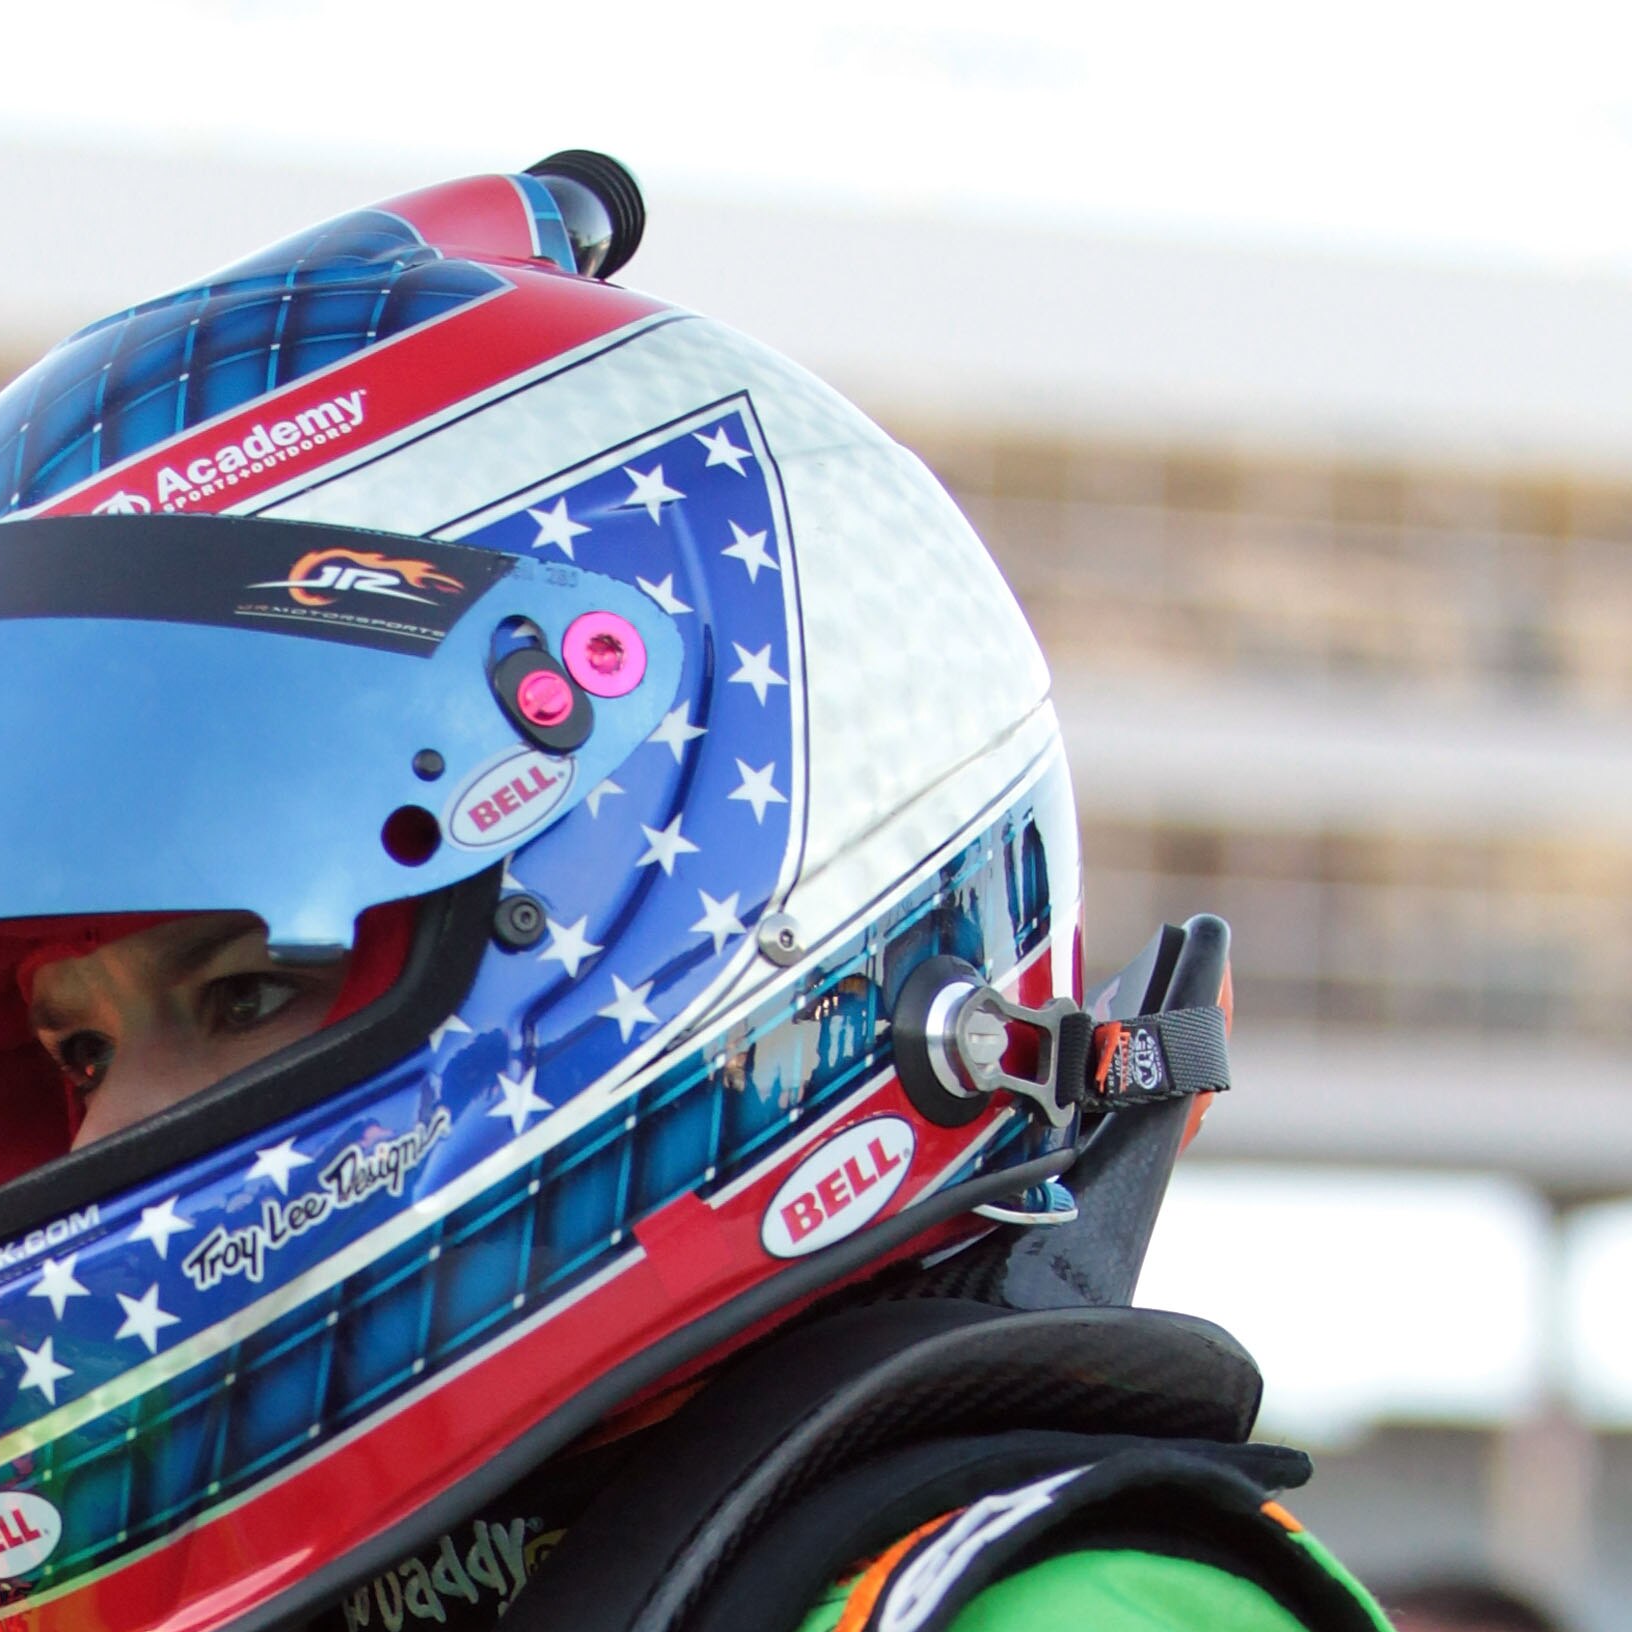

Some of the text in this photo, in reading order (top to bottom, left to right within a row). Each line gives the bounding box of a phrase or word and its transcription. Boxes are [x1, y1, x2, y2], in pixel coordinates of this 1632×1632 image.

[157, 389, 365, 503] Academy
[271, 605, 447, 637] MOTORSPORTS
[468, 766, 558, 833] BELL
[780, 1137, 902, 1244] BELL
[184, 1228, 262, 1288] Troy
[266, 1195, 329, 1247] Lee
